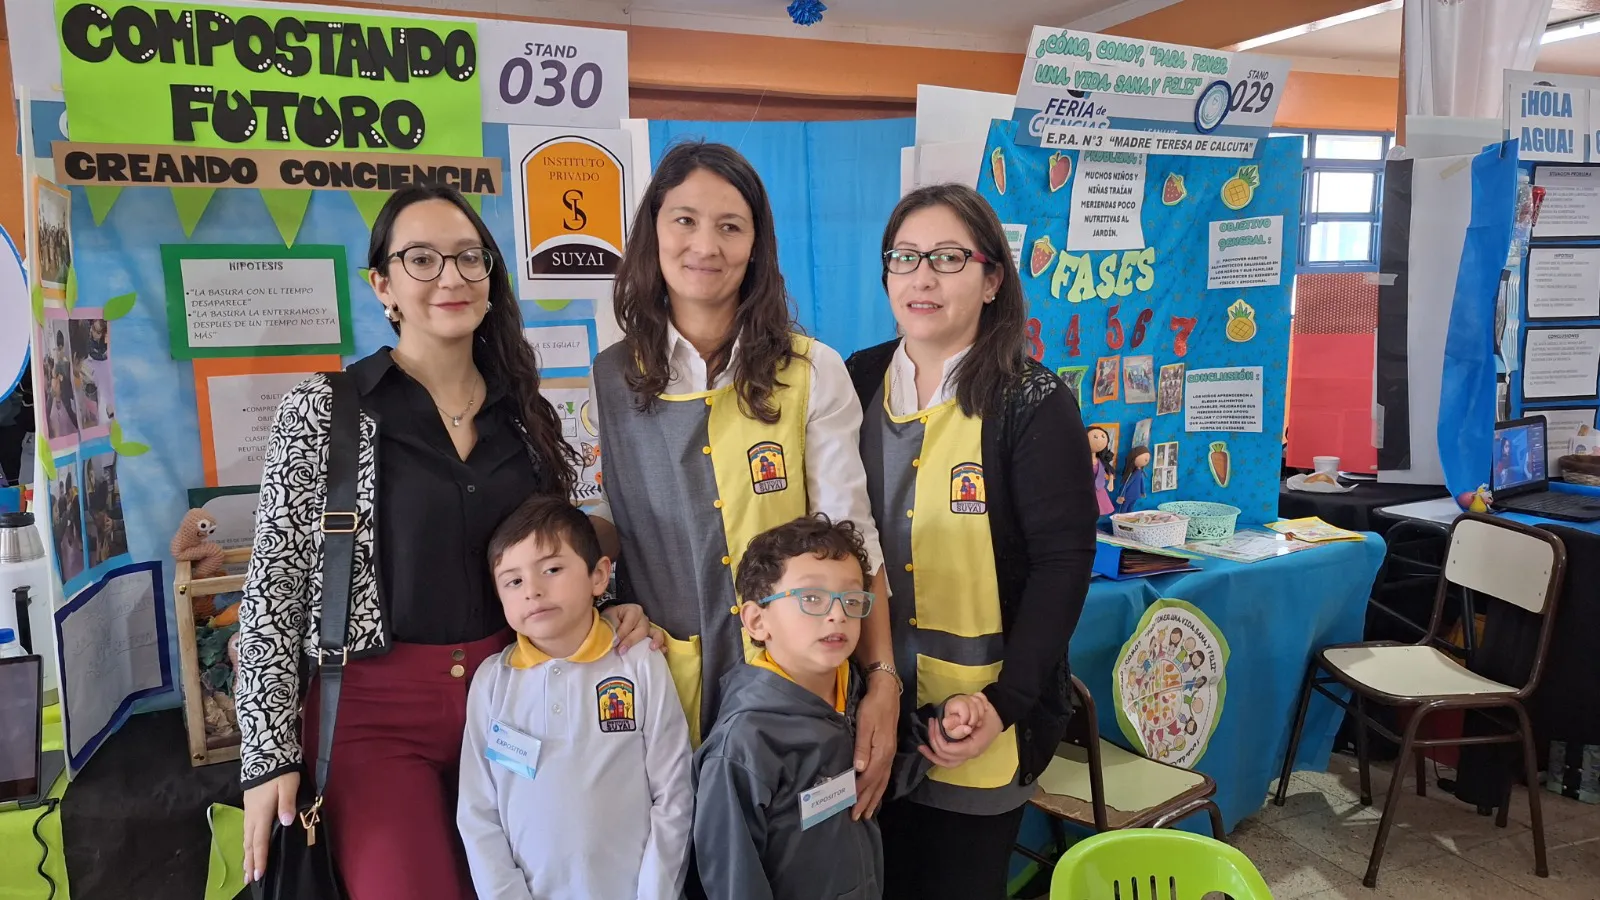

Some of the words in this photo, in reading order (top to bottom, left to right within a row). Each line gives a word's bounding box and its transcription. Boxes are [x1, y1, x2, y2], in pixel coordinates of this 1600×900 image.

[62, 3, 476, 83] COMPOSTANDO
[524, 41, 578, 60] STAND
[1192, 54, 1228, 74] TENER
[500, 56, 602, 108] 030
[1035, 64, 1070, 86] UNA
[1075, 70, 1112, 91] VIDA
[1114, 75, 1151, 95] SANA
[1152, 78, 1161, 95] Y
[1247, 70, 1268, 80] STAND
[1230, 80, 1274, 113] 029
[1521, 90, 1572, 118] ¡HOLA
[170, 83, 426, 150] FUTURO
[1045, 98, 1094, 118] FERIA
[1096, 105, 1106, 116] de
[1046, 133, 1078, 146] E.P.A.
[1156, 138, 1192, 150] TERESA
[1195, 140, 1208, 150] DE
[1520, 126, 1573, 154] AGUA!
[544, 156, 604, 168] INSTITUTO
[64, 151, 258, 184] CREANDO
[280, 159, 496, 194] CONCIENCIA
[550, 171, 600, 182] PRIVADO
[1085, 171, 1112, 180] MUCHOS
[1113, 170, 1134, 180] NIÑOS
[1134, 173, 1138, 181] Y
[1088, 184, 1108, 194] NIÑAS
[1081, 200, 1117, 209] MERIENDAS
[1118, 201, 1136, 209] POCO
[1219, 218, 1271, 232] OBJETIVO
[229, 262, 284, 271] HIPOTESIS
[552, 252, 604, 266] SUYAI
[1051, 247, 1156, 302] FASES
[208, 288, 244, 296] BASURA
[1066, 314, 1081, 356] 4
[1106, 304, 1124, 349] 5
[1131, 308, 1153, 348] 6
[1170, 316, 1198, 357] 7
[760, 480, 783, 491] SUYAI
[957, 502, 981, 512] SUYAI
[1182, 617, 1195, 632] VIDA
[607, 721, 630, 730] SUYAI
[496, 738, 528, 756] EXPOSITOR
[811, 788, 846, 808] EXPOSITOR
